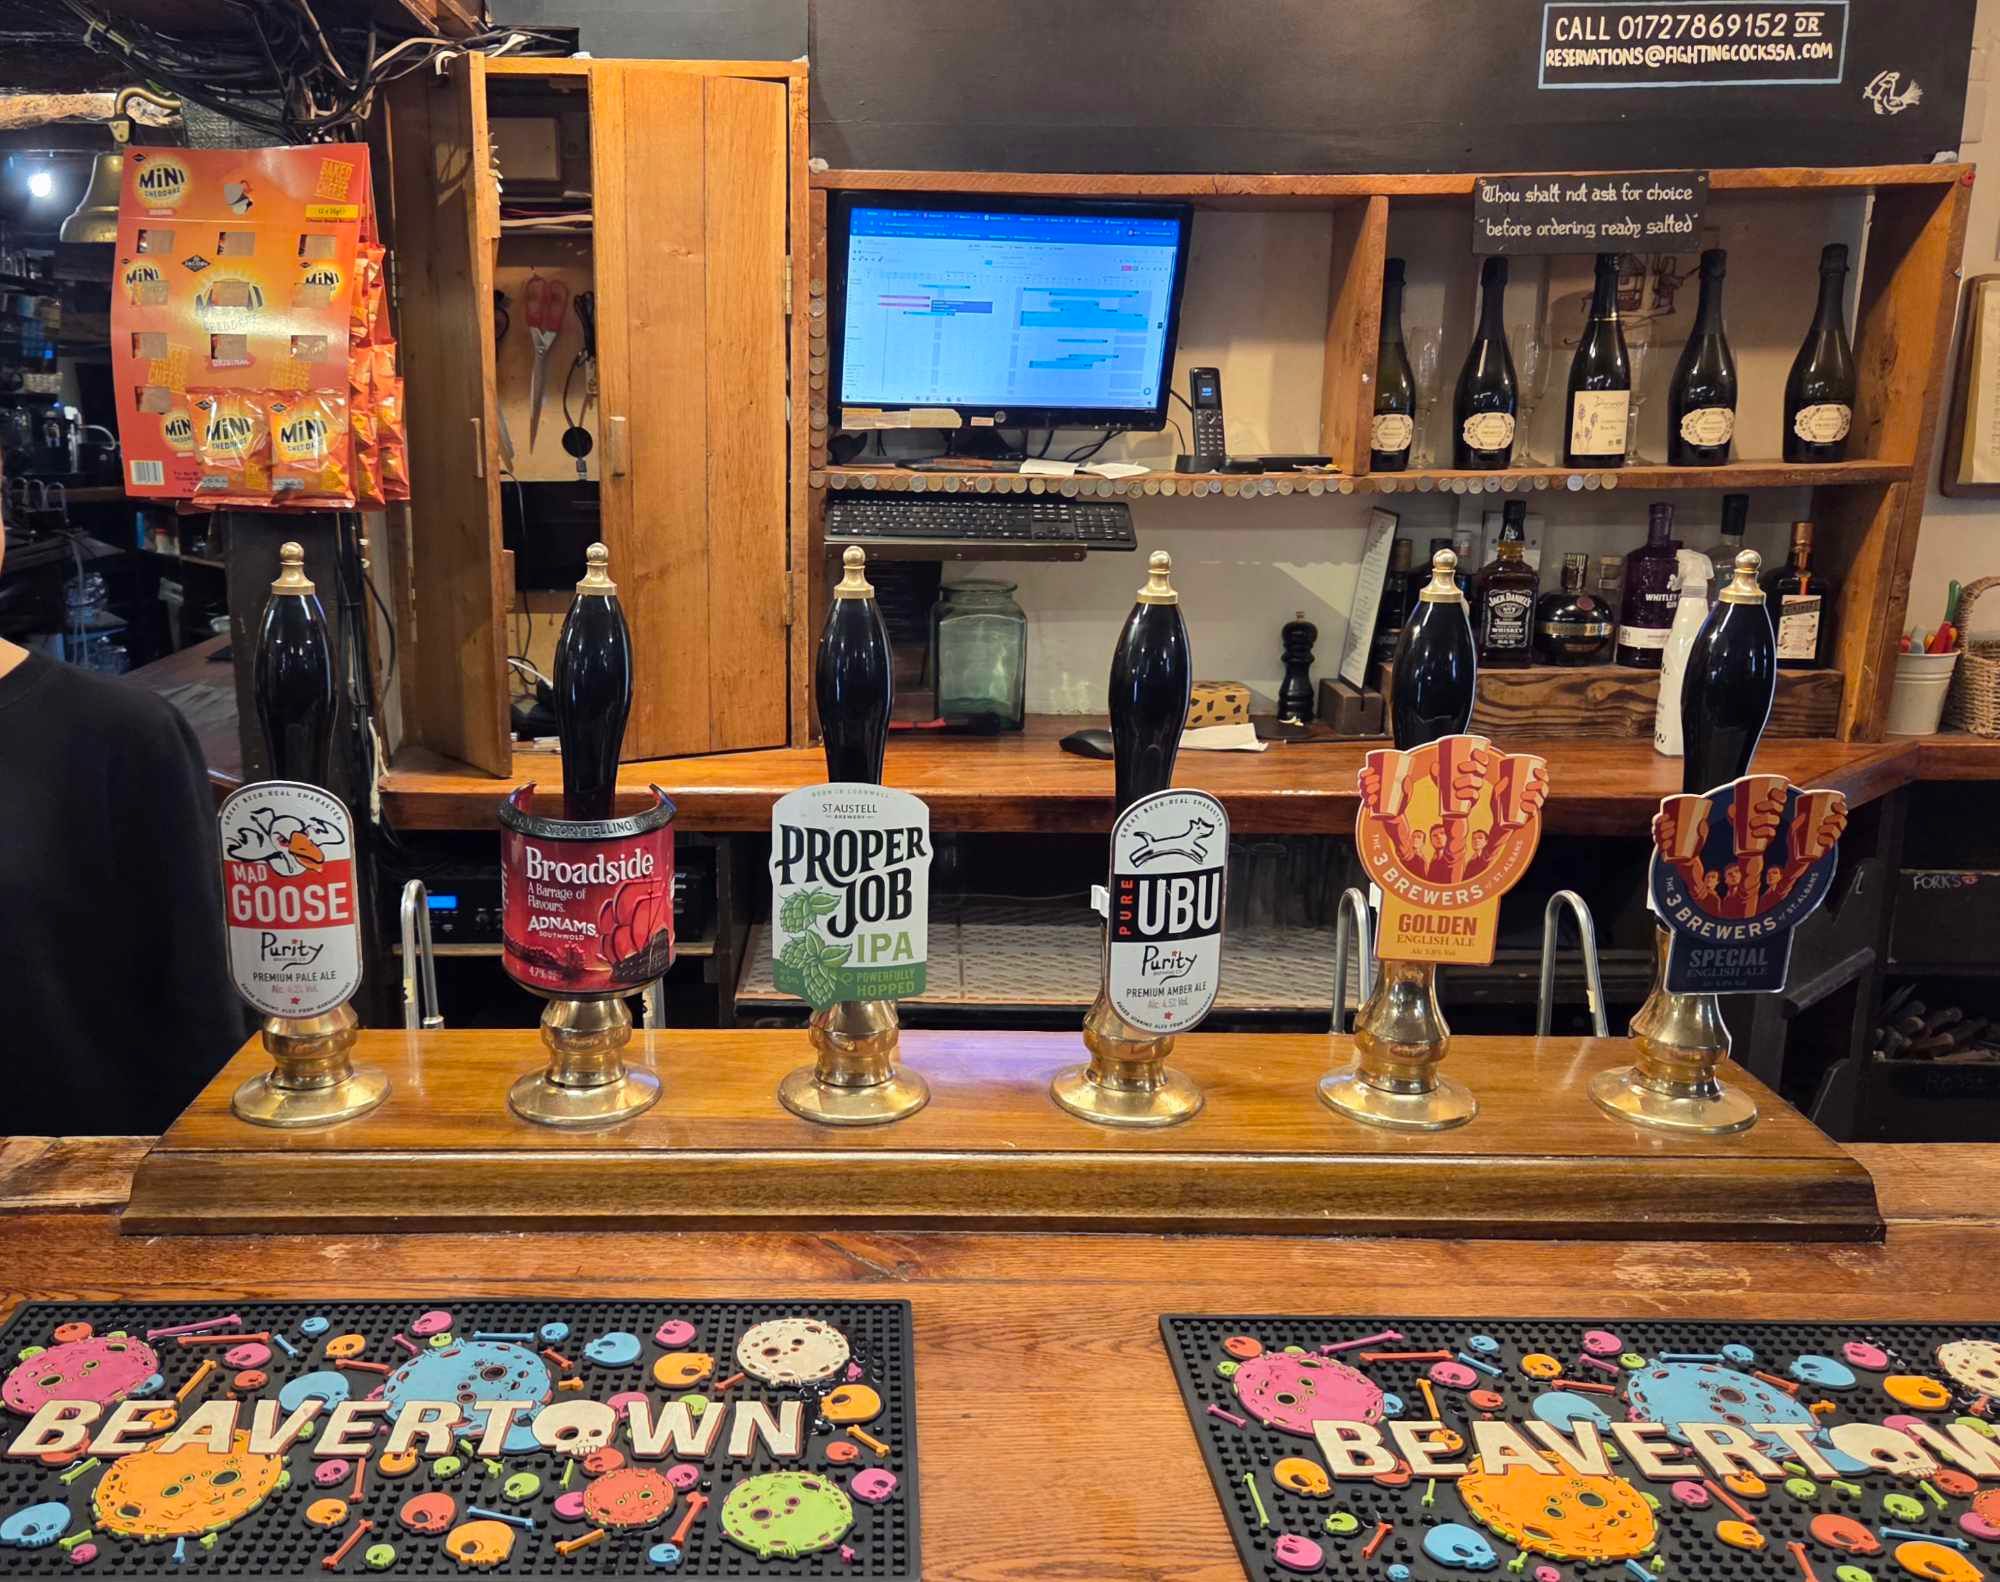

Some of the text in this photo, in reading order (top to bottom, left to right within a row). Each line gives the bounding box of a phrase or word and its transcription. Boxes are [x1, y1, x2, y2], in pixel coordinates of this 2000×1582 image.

[1555, 13, 1819, 41] CALL 01727869152 OR
[1482, 182, 1693, 203] Thou shalt not ask for choice
[1486, 217, 1531, 237] before
[1536, 217, 1596, 238] ordering
[1601, 216, 1641, 238] ready
[833, 803, 878, 813] AUSTELL
[526, 846, 654, 885] Broadside
[775, 824, 927, 888] PROPER
[233, 864, 267, 883] MAD
[1373, 852, 1389, 866] 3
[1382, 867, 1484, 906] BREWERS
[1913, 875, 1962, 890] FORKS
[528, 882, 586, 901] A Barrage of
[232, 882, 349, 923] GOOSE
[827, 867, 913, 938] JOB
[1119, 879, 1134, 935] PURE
[1138, 872, 1220, 936] UBU
[1666, 894, 1682, 906] 3
[1675, 906, 1777, 940] BREWERS
[1799, 872, 1819, 902] ALBANS
[527, 915, 597, 936] ADNAMS
[1398, 913, 1477, 936] GOLDEN
[539, 931, 585, 940] SOUTHWOLD
[1396, 935, 1474, 947] ENGLISH ALE
[261, 932, 324, 971] Purity
[857, 931, 914, 963] IPA
[1142, 945, 1198, 985] Purity
[1689, 948, 1769, 968] SPECIAL
[253, 970, 337, 982] PREMIUM PALE ALE
[857, 968, 915, 984] POWERFULLY
[1686, 967, 1741, 977] ENGLISH
[857, 981, 915, 997] HOPPED
[1126, 981, 1207, 998] PREMIUM AMBER ALE
